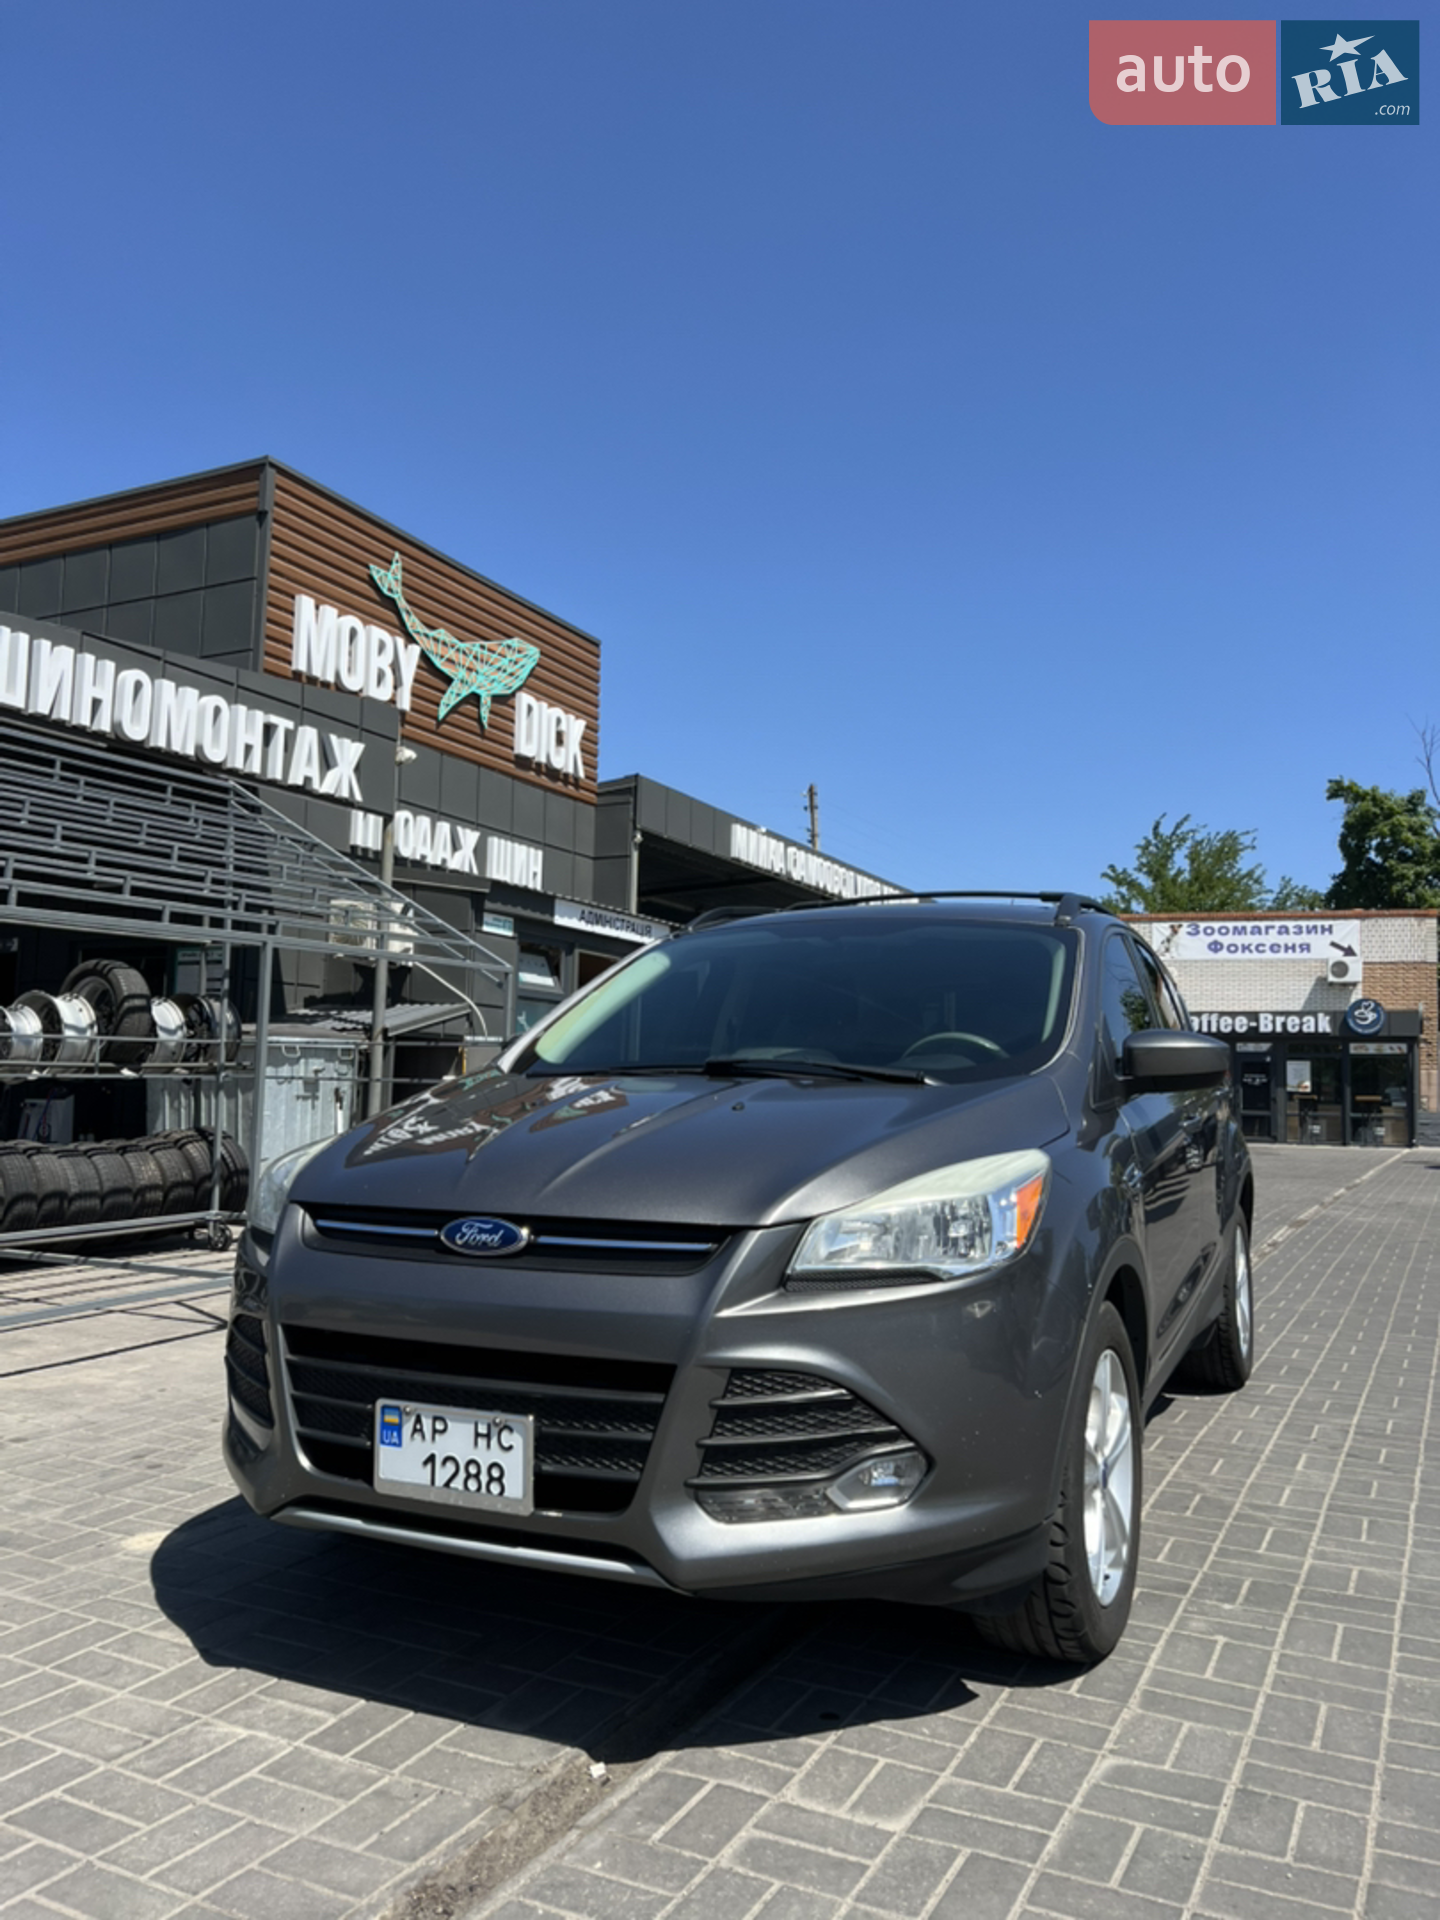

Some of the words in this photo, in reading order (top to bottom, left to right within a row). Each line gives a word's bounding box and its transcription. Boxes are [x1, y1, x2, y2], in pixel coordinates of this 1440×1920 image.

[291, 594, 422, 712] MOBY
[513, 692, 587, 779] DICK
[486, 836, 544, 893] ШИН
[1185, 922, 1334, 937] Зоомагазин
[1206, 939, 1312, 955] Фоксеня
[1189, 1012, 1333, 1034] offee-Break
[455, 1221, 505, 1247] Ford
[383, 1429, 400, 1445] UA
[422, 1452, 506, 1497] 1288
